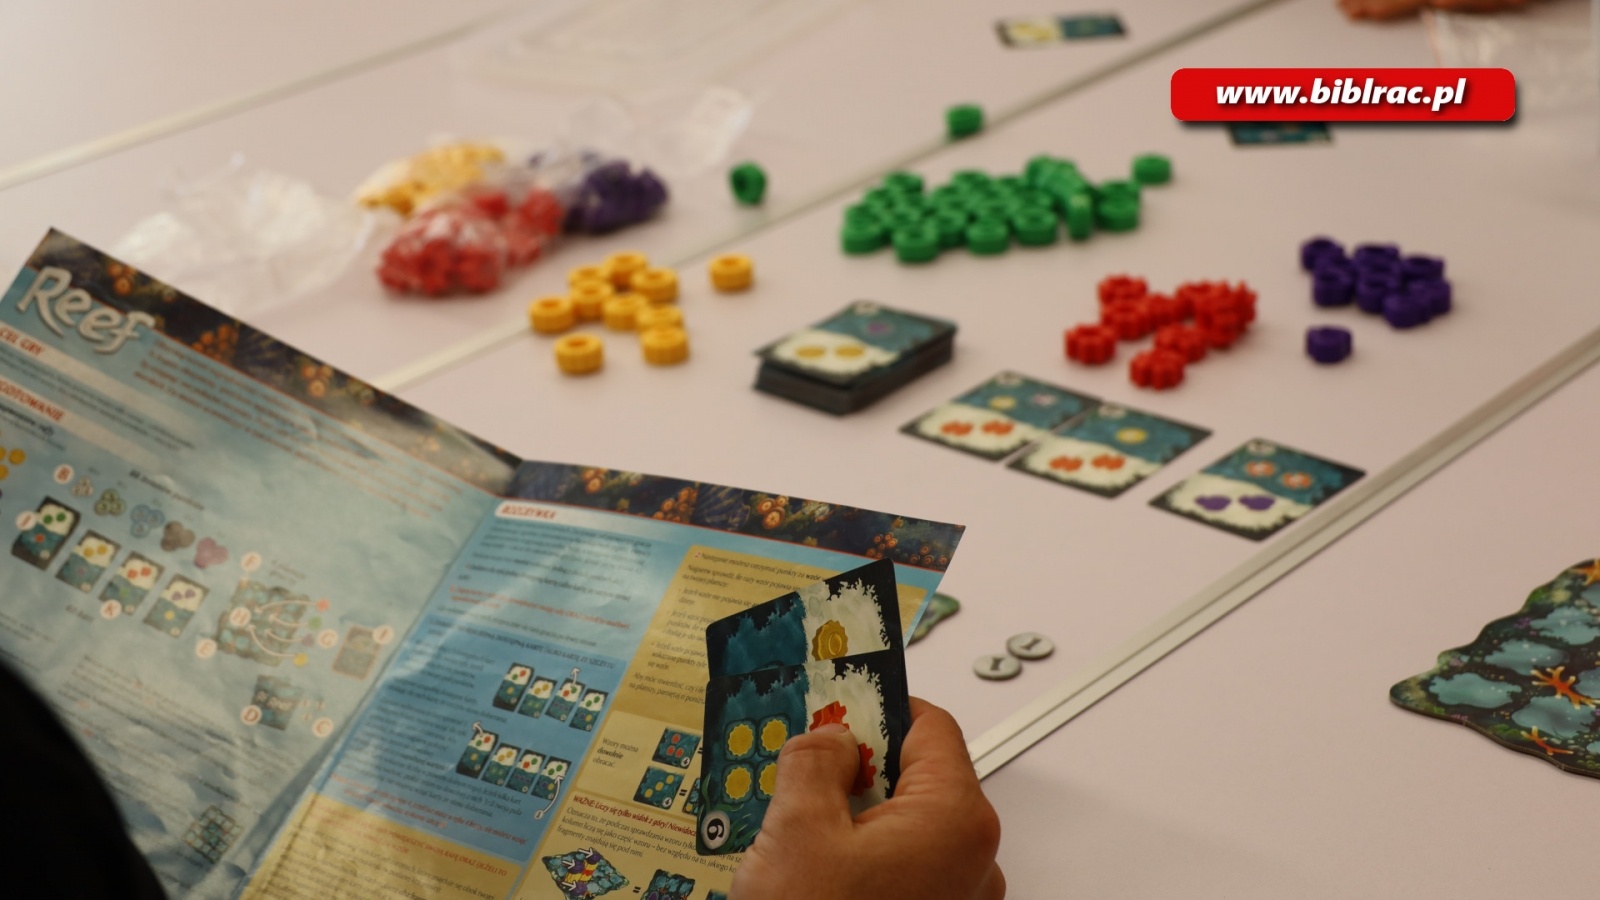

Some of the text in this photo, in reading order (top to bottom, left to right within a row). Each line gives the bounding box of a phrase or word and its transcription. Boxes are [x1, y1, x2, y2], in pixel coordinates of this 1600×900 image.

[16, 266, 156, 355] Reef
[597, 747, 623, 759] dowolnie
[602, 738, 639, 753] Wzory można
[566, 806, 590, 820] Oznacza
[606, 819, 629, 831] podczas
[630, 827, 664, 841] sprawdzania
[664, 836, 681, 846] wzoru
[682, 841, 696, 851] tylko
[595, 801, 610, 813] Liczy
[609, 806, 617, 816] się
[617, 809, 631, 818] tylko
[631, 813, 648, 824] widok
[652, 819, 668, 829] góry!
[557, 825, 585, 840] fragmenty
[585, 835, 608, 849] znajdują
[609, 841, 617, 851] się
[617, 844, 631, 854] pod
[562, 815, 583, 827] kolumn
[583, 822, 596, 833] liczą
[596, 827, 604, 836] się
[604, 830, 617, 839] jako
[617, 833, 632, 844] część
[633, 839, 650, 849] wzoru
[656, 845, 666, 854] bez
[668, 848, 692, 860] względu
[692, 855, 699, 863] na
[706, 860, 728, 872] jakiego
